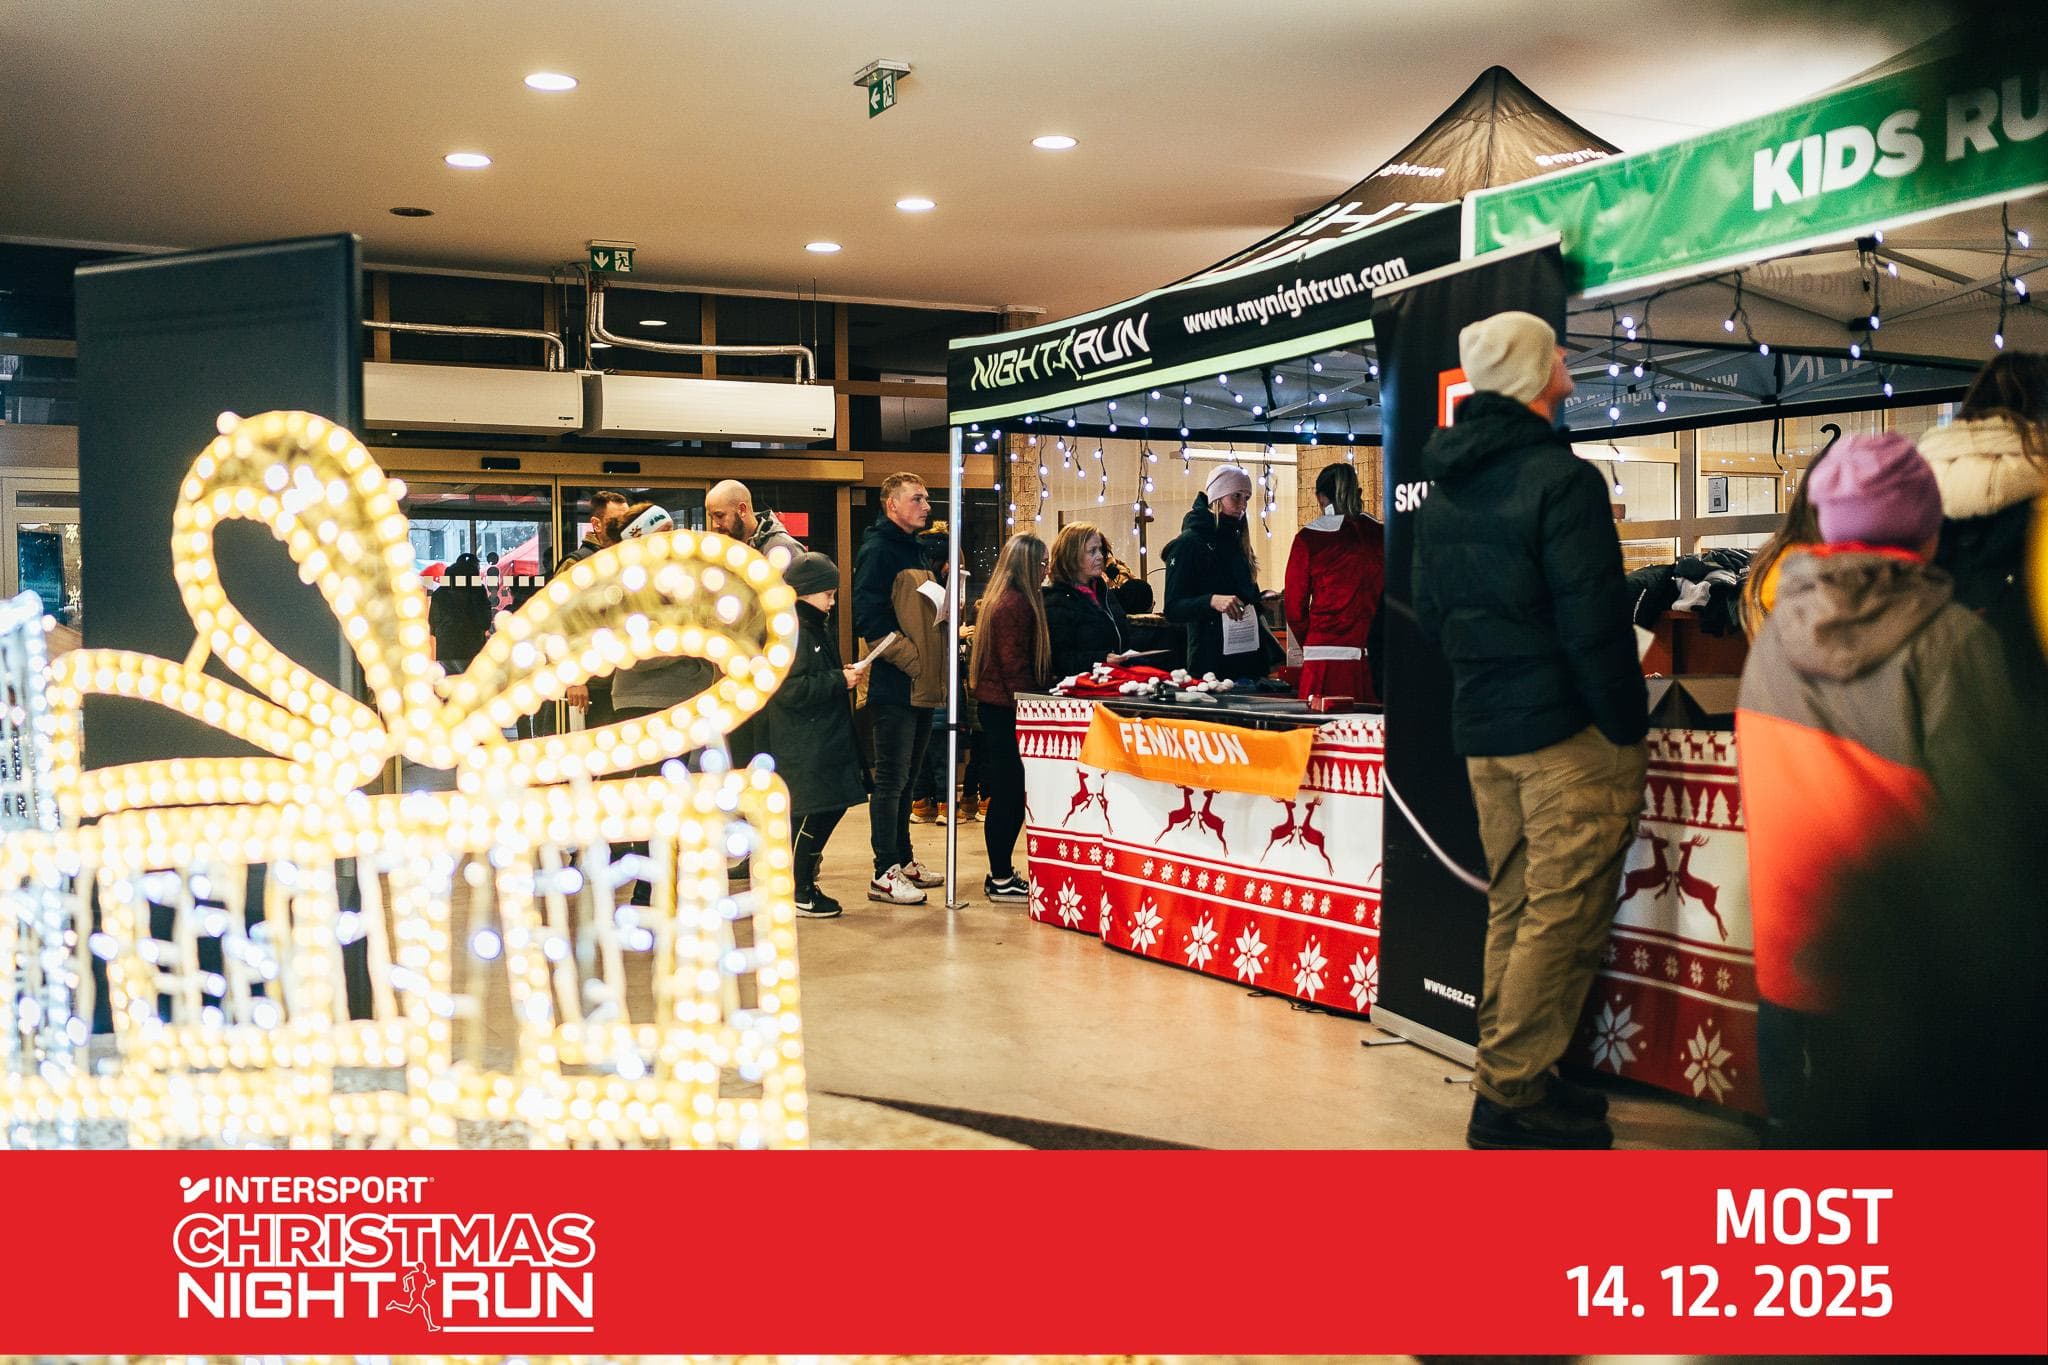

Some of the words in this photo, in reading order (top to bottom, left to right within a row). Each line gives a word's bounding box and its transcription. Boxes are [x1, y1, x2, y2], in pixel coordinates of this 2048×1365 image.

[1752, 108, 1924, 212] KIDS
[1183, 257, 1409, 335] www.mynightrun.com
[970, 338, 1061, 391] NIGHT
[1073, 312, 1150, 369] RUN
[1423, 977, 1477, 1009] www.cez.cz
